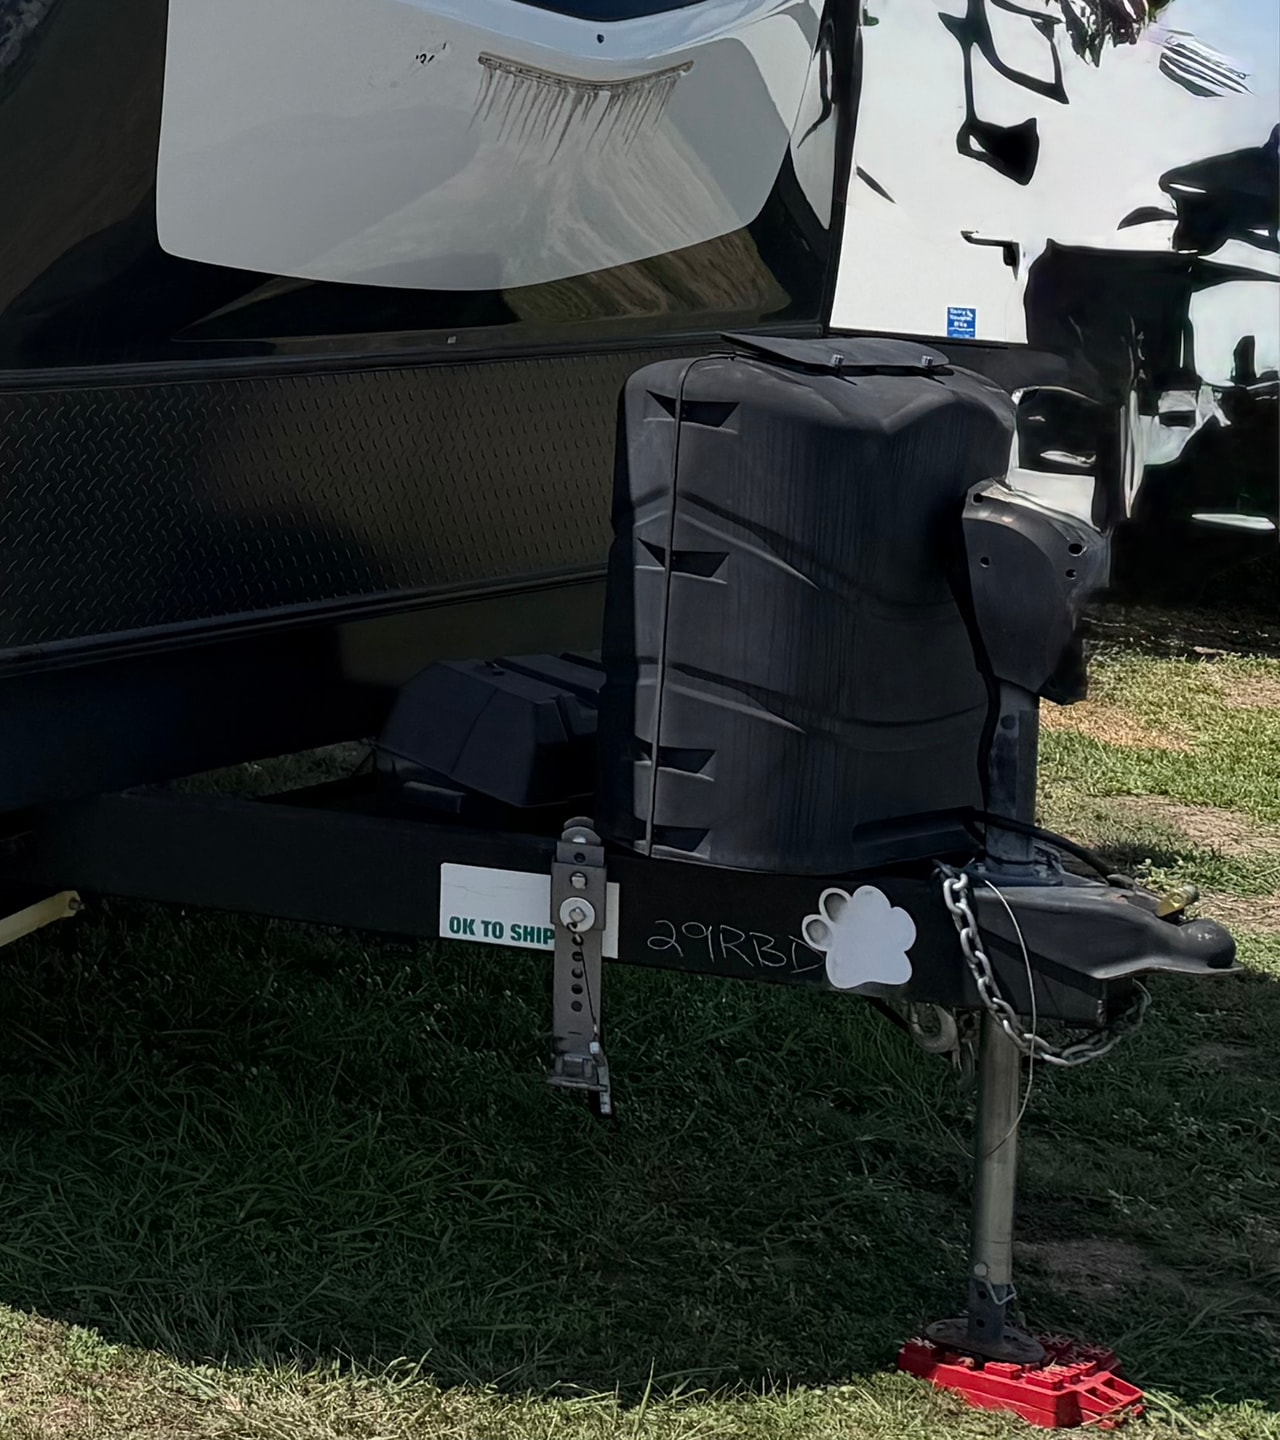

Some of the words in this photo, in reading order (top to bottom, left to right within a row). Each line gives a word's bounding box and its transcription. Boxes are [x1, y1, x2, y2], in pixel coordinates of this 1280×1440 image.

[449, 915, 477, 936] OK
[481, 919, 505, 940] TO
[510, 923, 556, 946] SHIP
